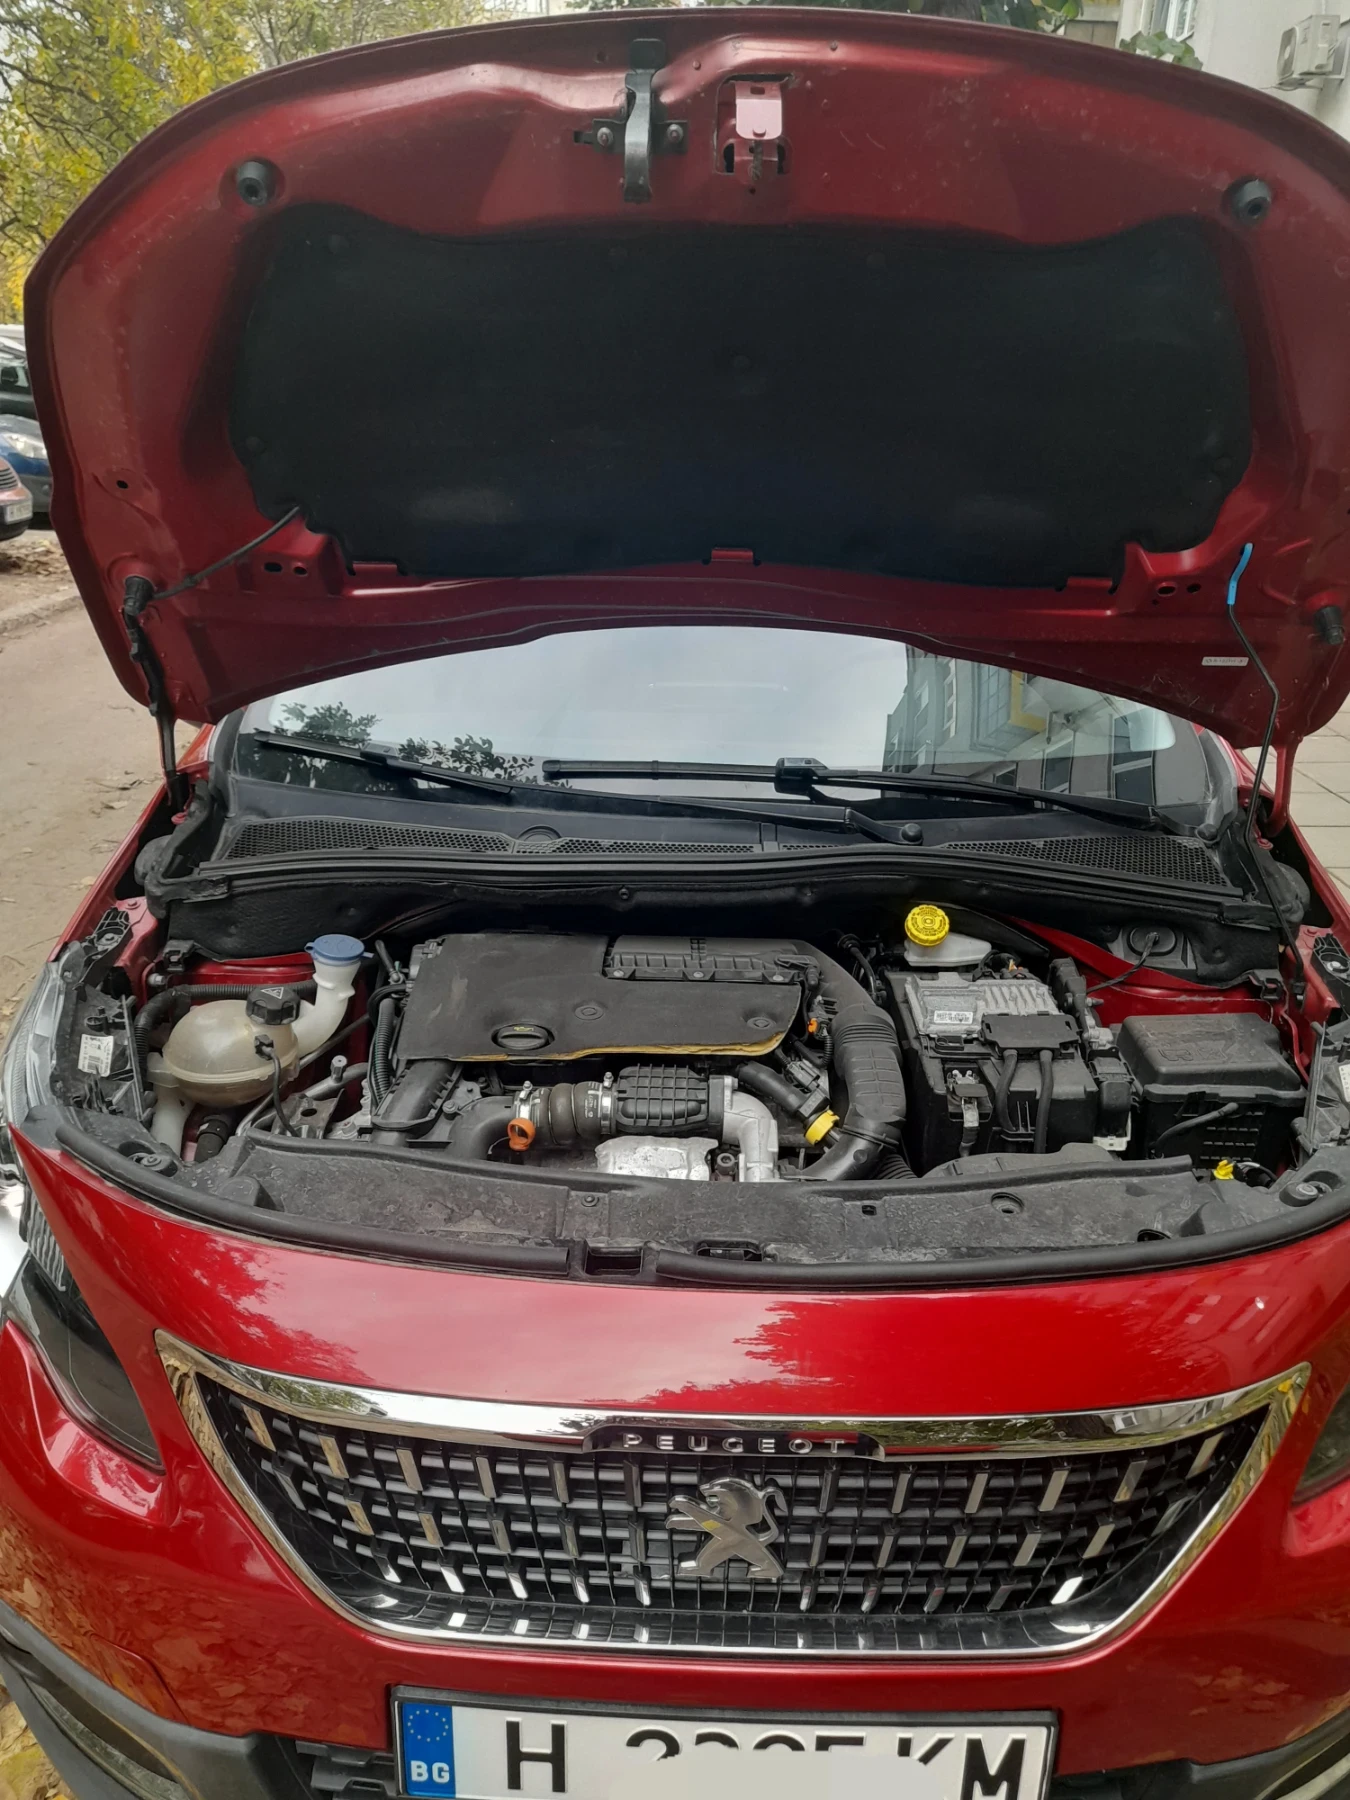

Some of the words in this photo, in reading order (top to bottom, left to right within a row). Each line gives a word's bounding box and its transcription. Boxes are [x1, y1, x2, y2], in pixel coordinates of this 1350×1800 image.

[622, 1433, 845, 1453] PEUGEOT
[506, 1720, 566, 1793] H
[410, 1760, 450, 1783] BG
